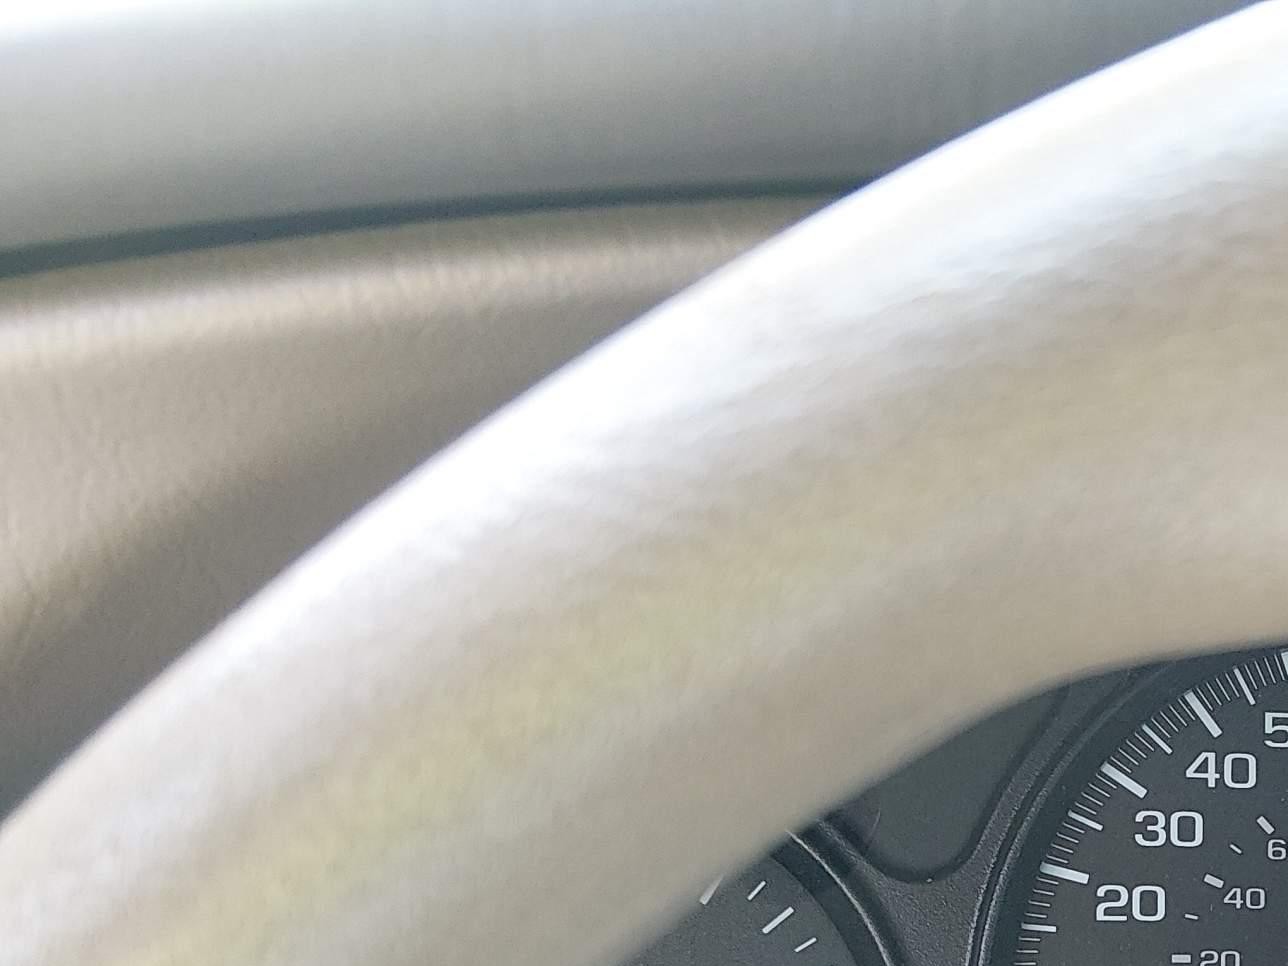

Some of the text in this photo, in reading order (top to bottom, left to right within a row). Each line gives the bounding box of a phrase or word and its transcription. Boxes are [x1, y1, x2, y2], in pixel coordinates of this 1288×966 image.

[1186, 752, 1256, 788] 40
[1135, 811, 1203, 847] 30
[1096, 885, 1165, 921] 20
[1224, 888, 1265, 909] 40
